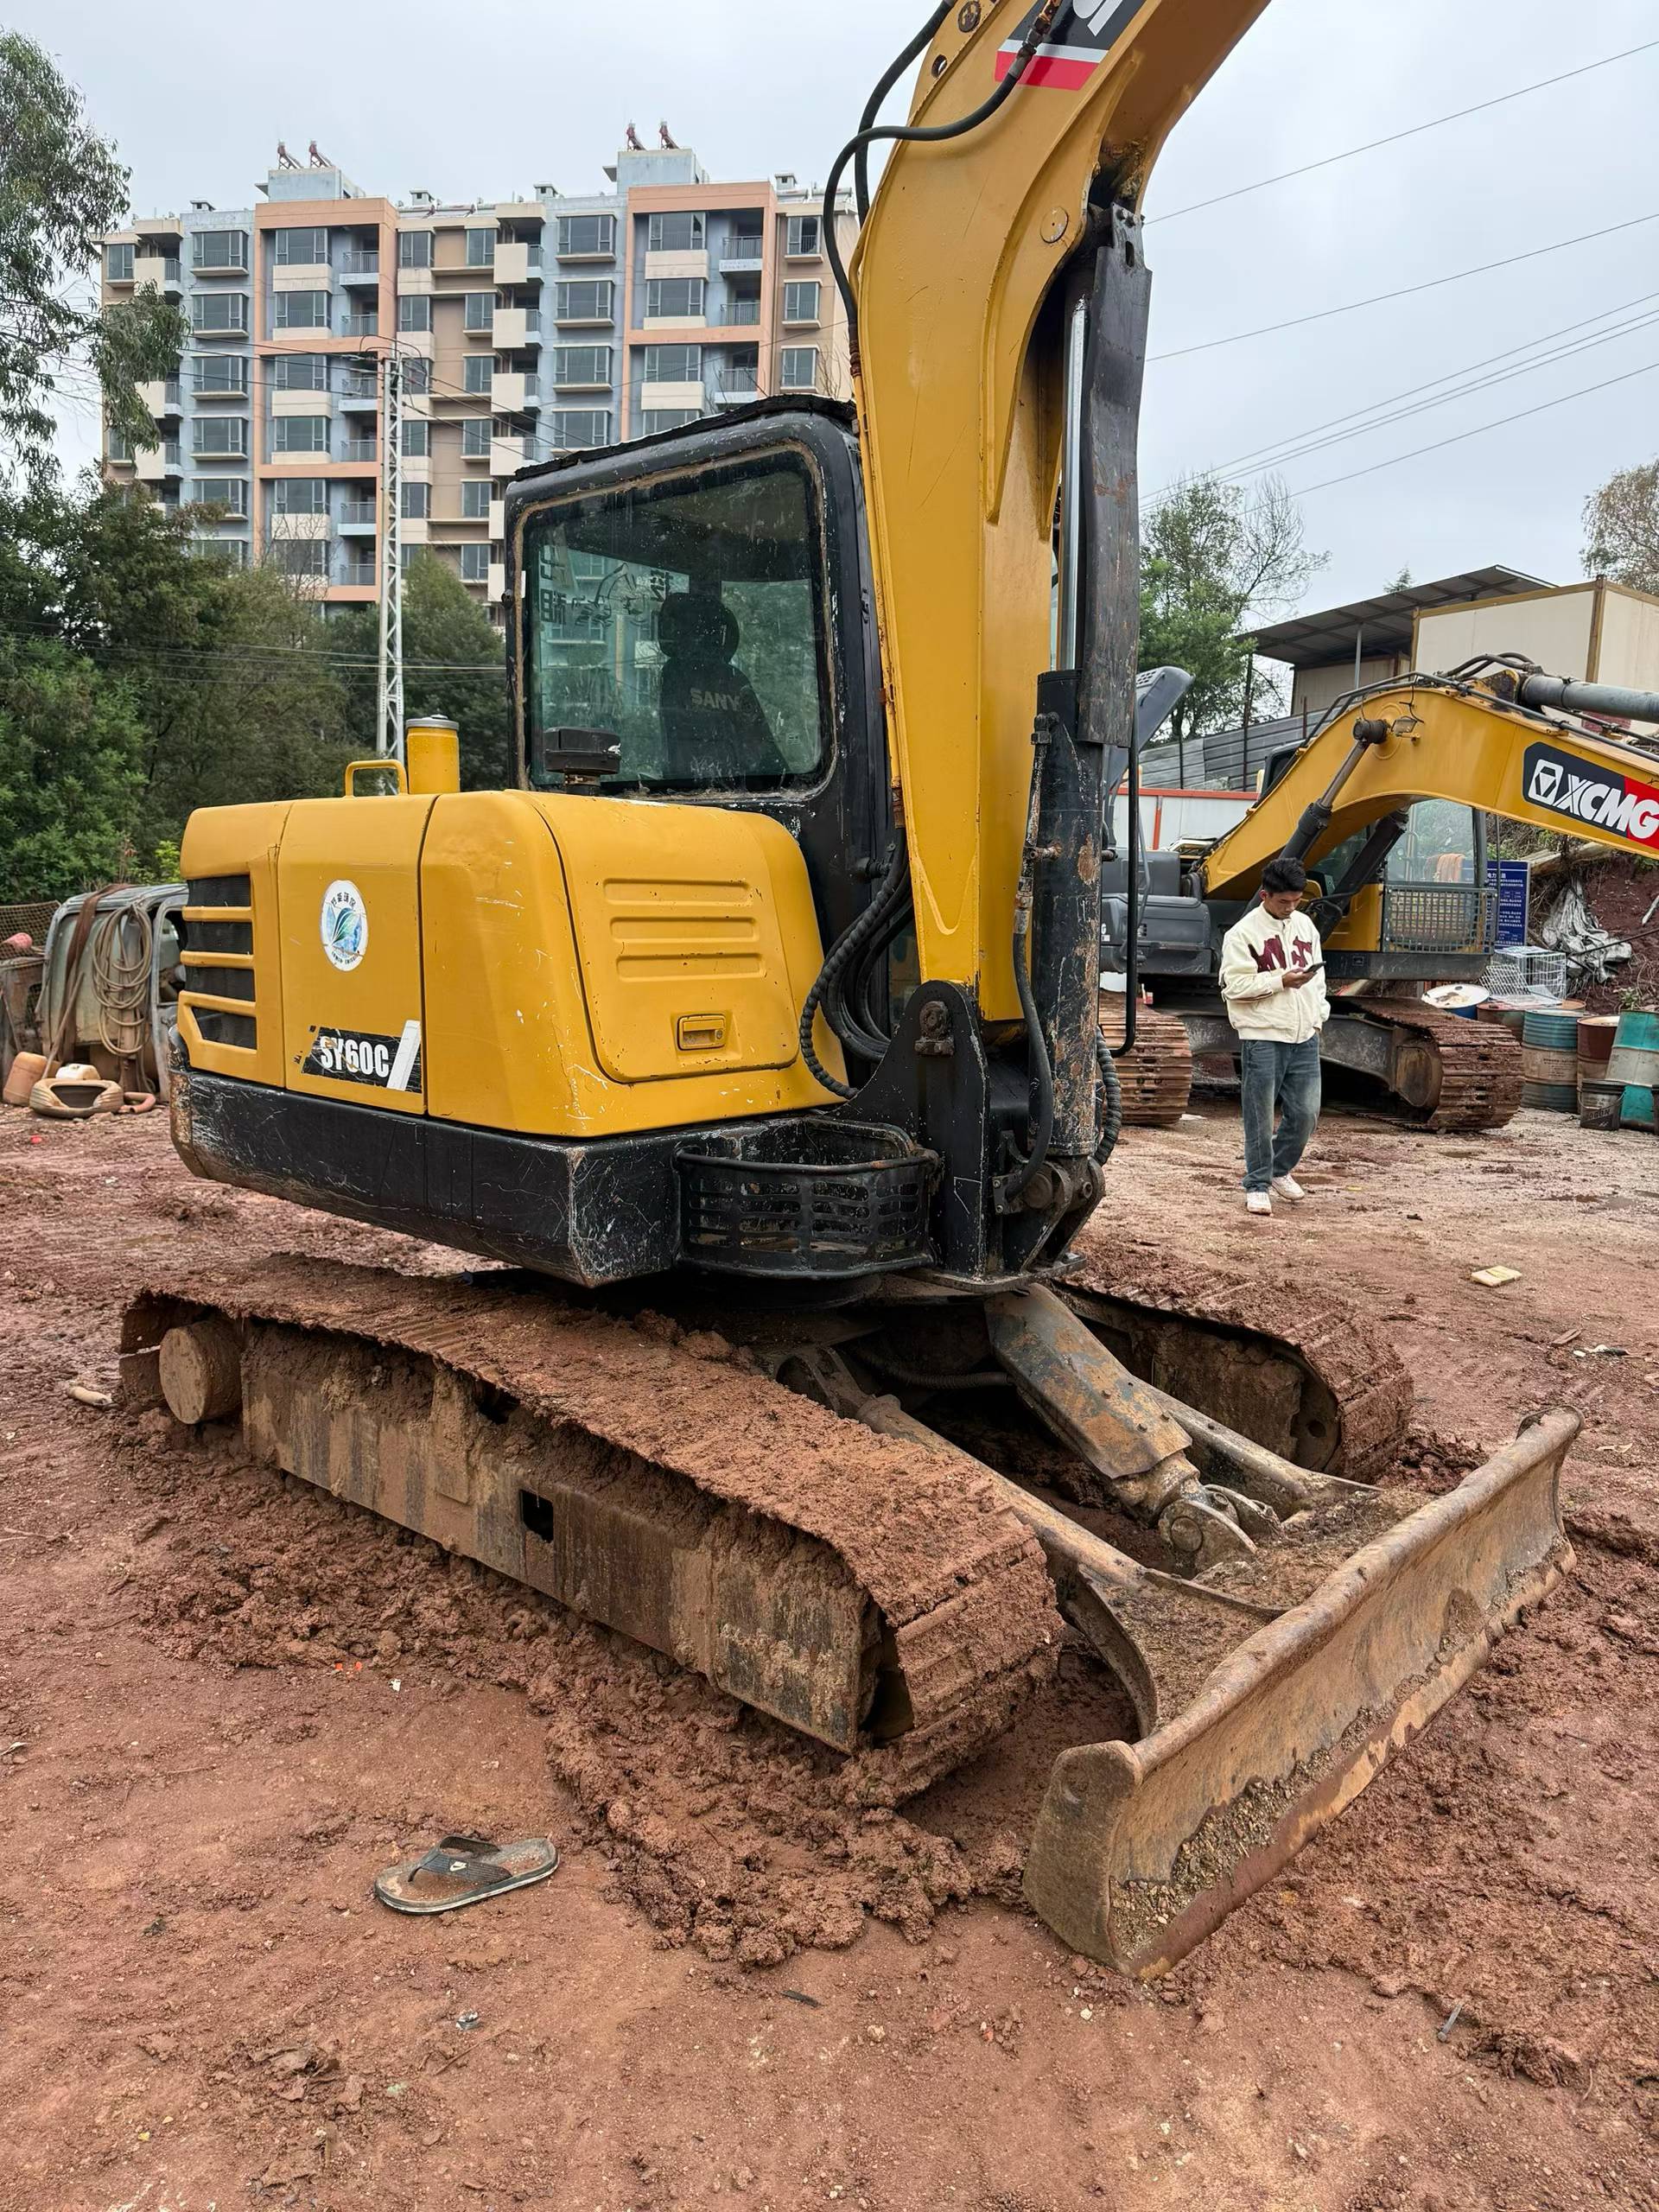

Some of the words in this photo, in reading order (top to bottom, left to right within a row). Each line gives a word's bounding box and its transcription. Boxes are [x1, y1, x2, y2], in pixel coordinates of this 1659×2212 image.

[690, 687, 741, 711] SANY
[1553, 773, 1659, 839] XCMG
[320, 1036, 389, 1077] SY60C
